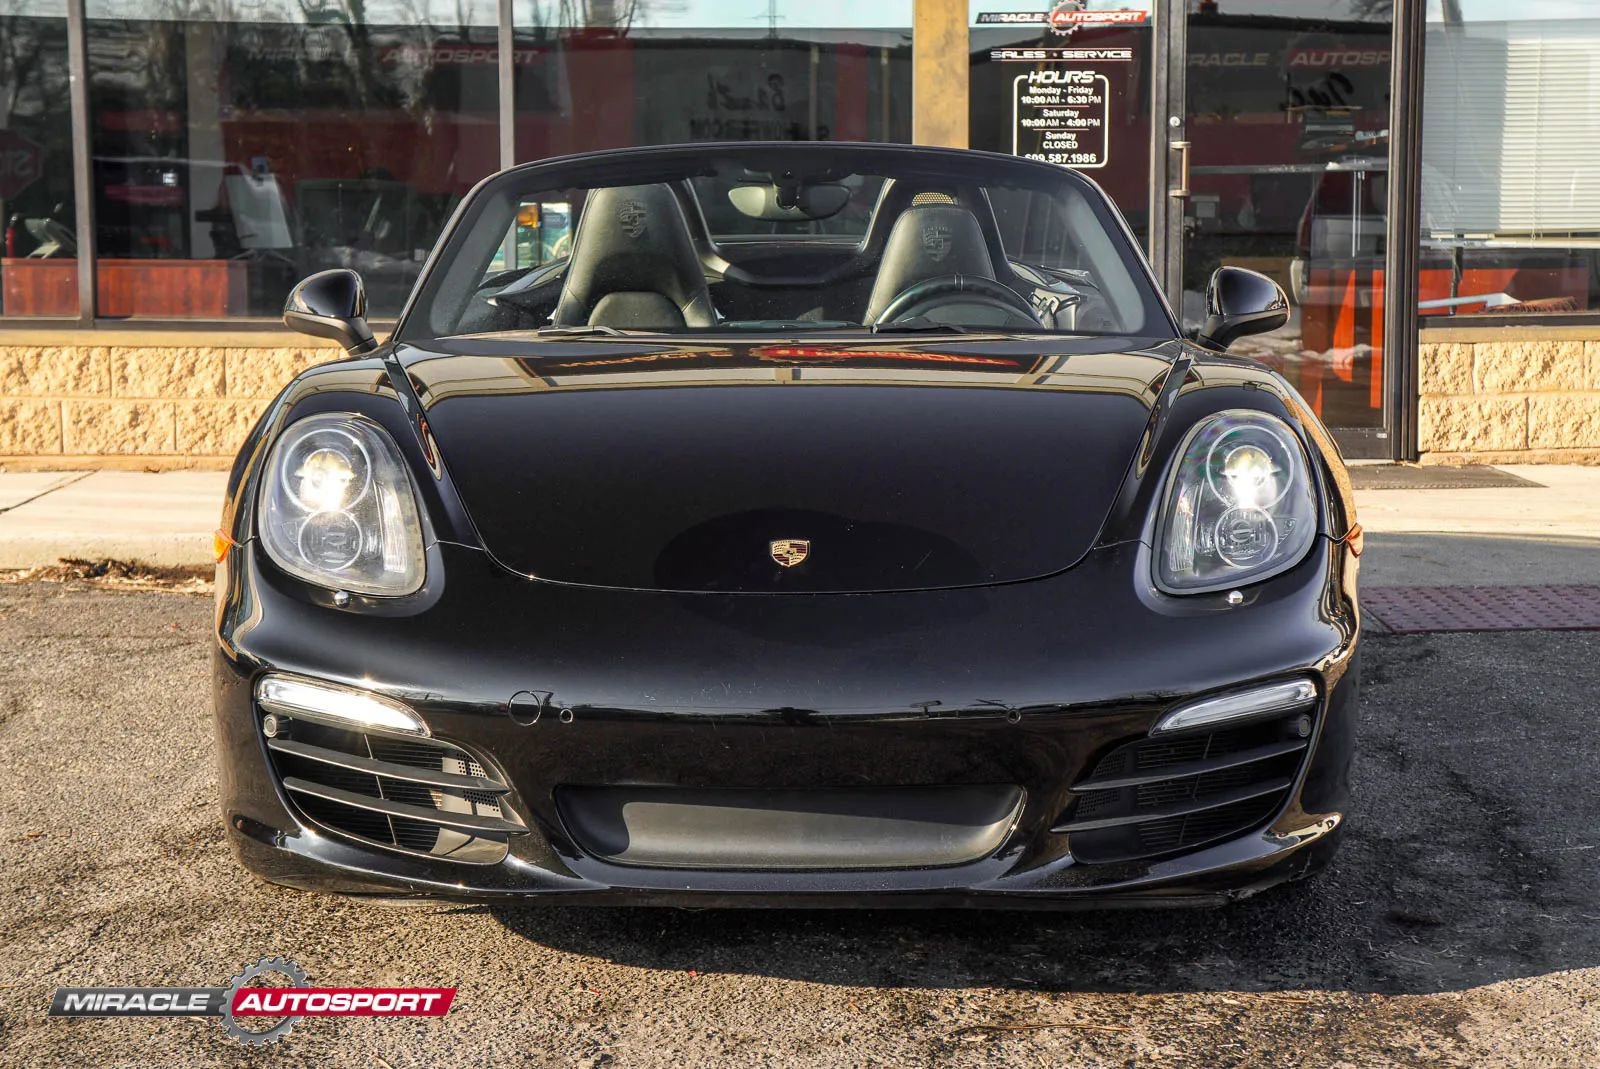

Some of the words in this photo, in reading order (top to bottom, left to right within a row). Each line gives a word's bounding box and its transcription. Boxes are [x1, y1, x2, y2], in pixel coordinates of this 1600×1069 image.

[981, 13, 1044, 22] MIRACLE
[1055, 12, 1142, 22] AUTOSPORT
[990, 51, 1046, 59] SALES
[1062, 51, 1132, 59] SERVICE
[1187, 53, 1270, 66] RACLE
[1290, 51, 1391, 66] AUTOSP
[1028, 70, 1096, 84] HOURS
[1029, 86, 1061, 95] Monday
[1067, 86, 1094, 95] Friday
[1043, 109, 1079, 118] Saturday
[1045, 131, 1076, 140] Sunday
[1043, 141, 1078, 149] CLOSED
